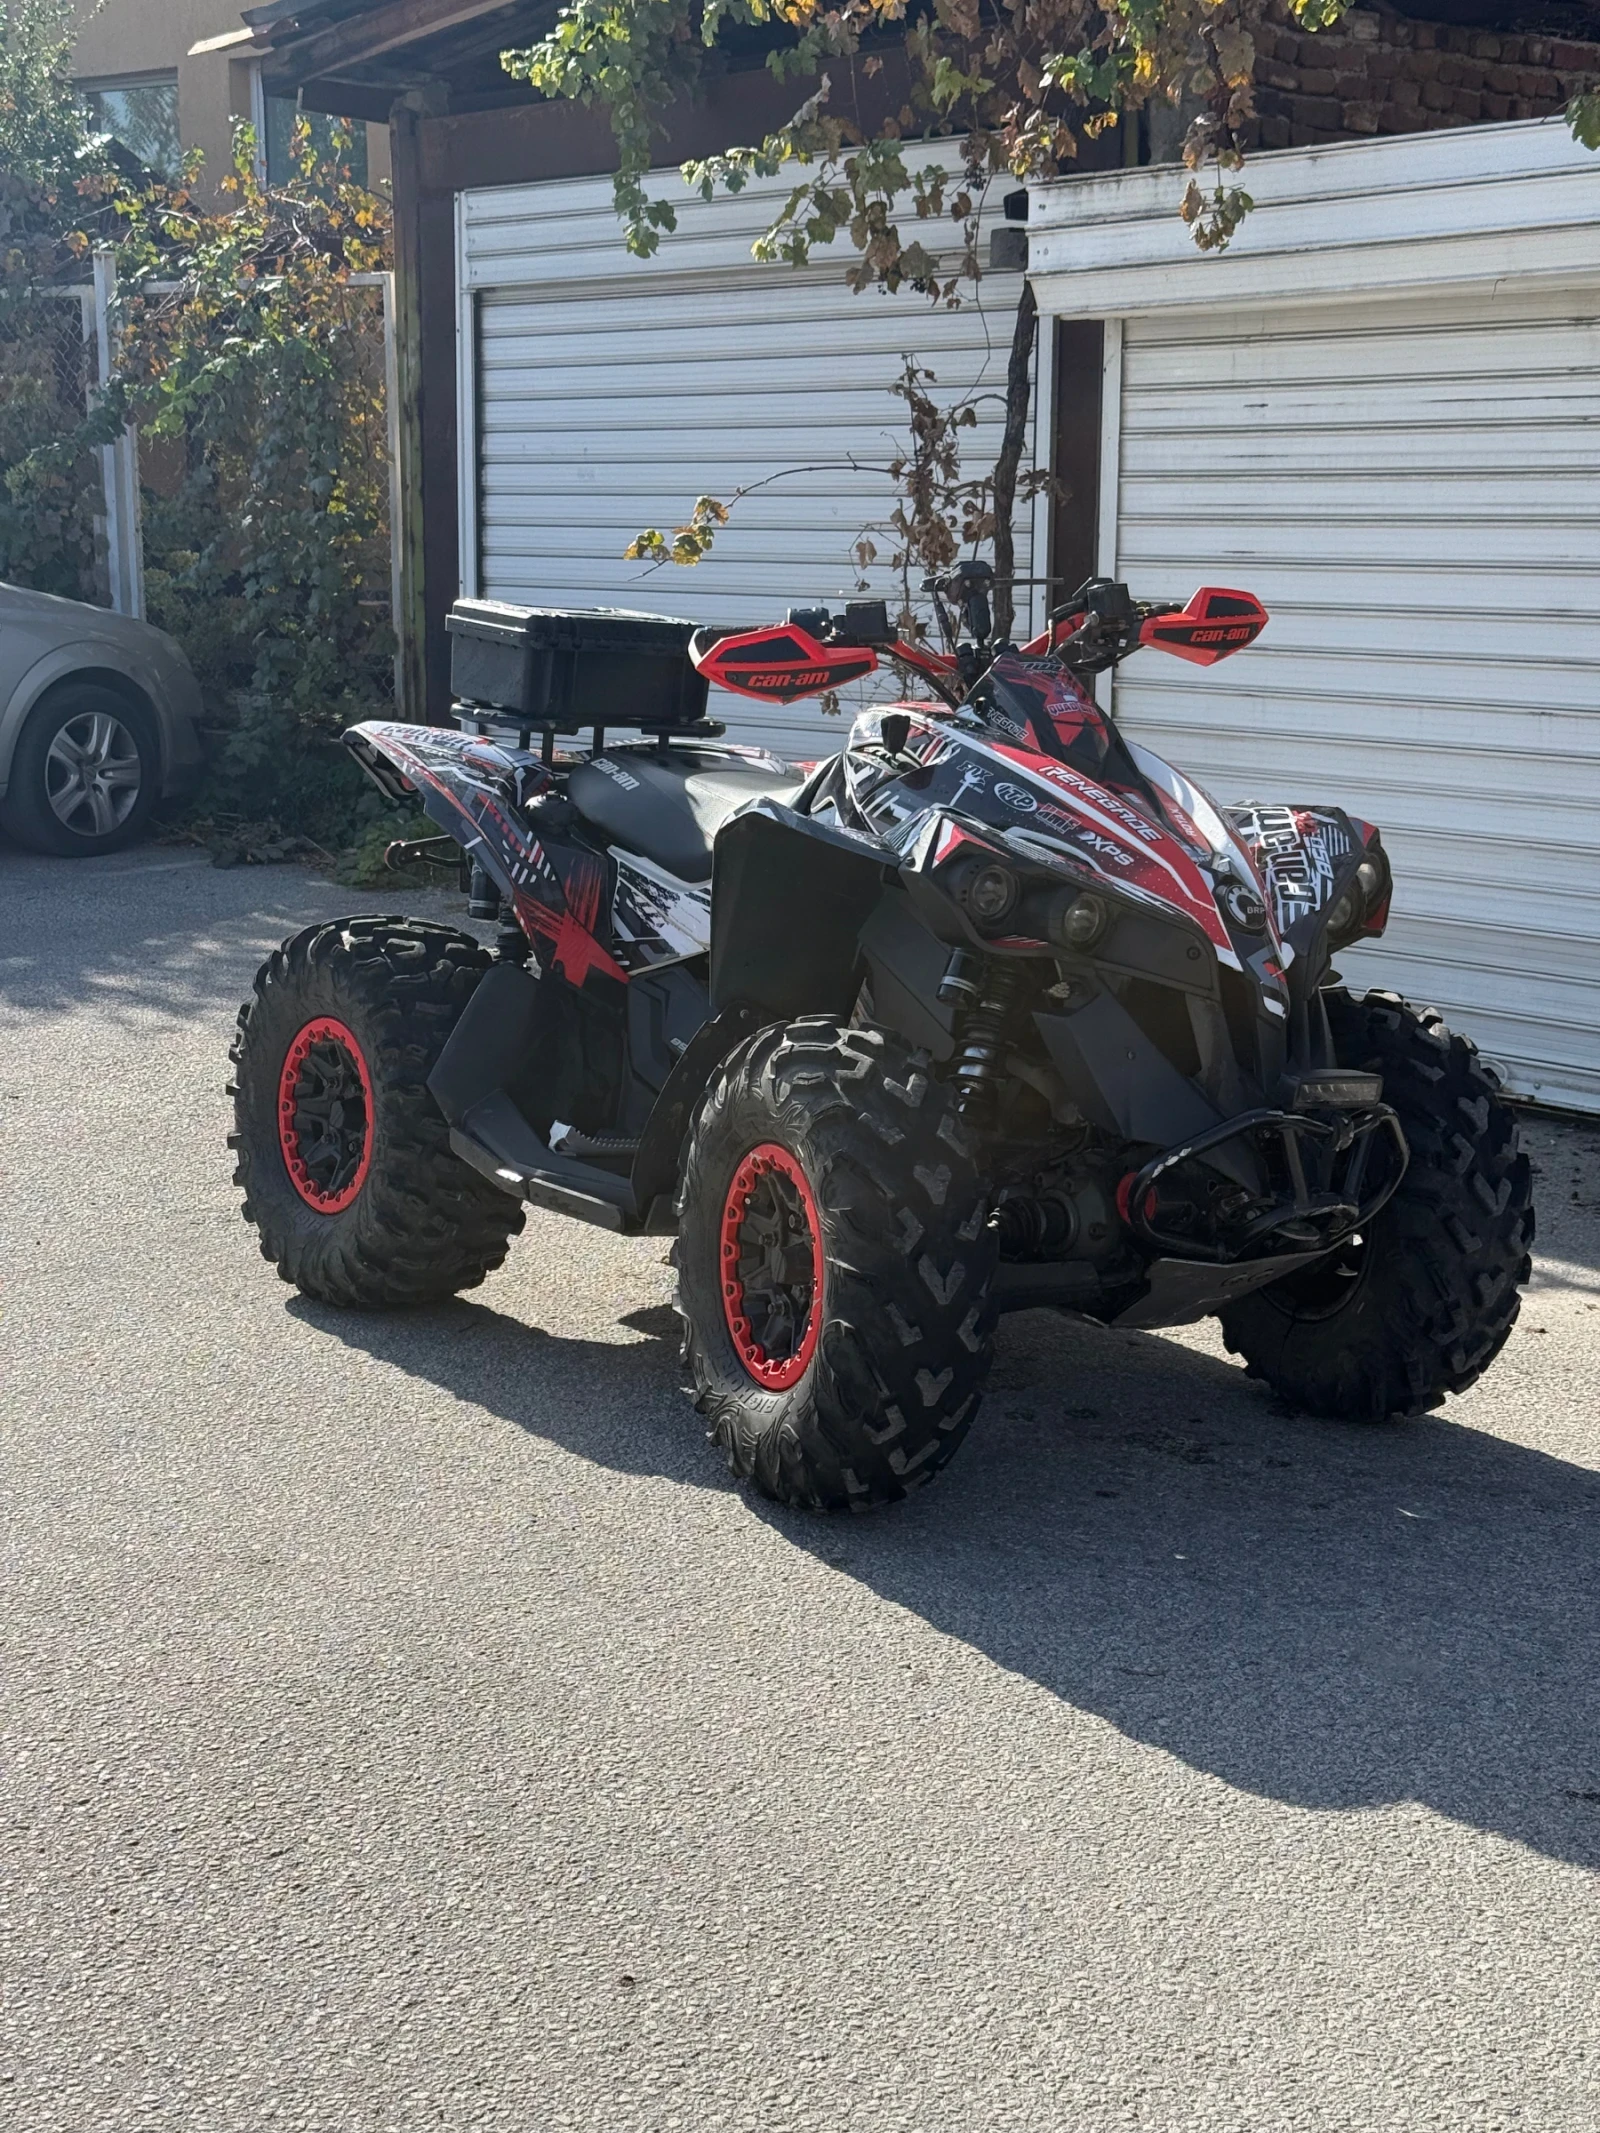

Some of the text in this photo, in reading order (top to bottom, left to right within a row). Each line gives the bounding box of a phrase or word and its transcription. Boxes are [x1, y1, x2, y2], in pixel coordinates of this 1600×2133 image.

[1190, 628, 1250, 642] can-am
[747, 671, 830, 687] can-am
[1047, 702, 1079, 715] QUAD
[590, 757, 640, 791] can-am
[956, 760, 994, 787] FOX
[997, 782, 1035, 811] ITP
[1038, 765, 1163, 841] RENEGADE
[1170, 808, 1197, 837] ROTAX
[1087, 834, 1134, 866] XPS
